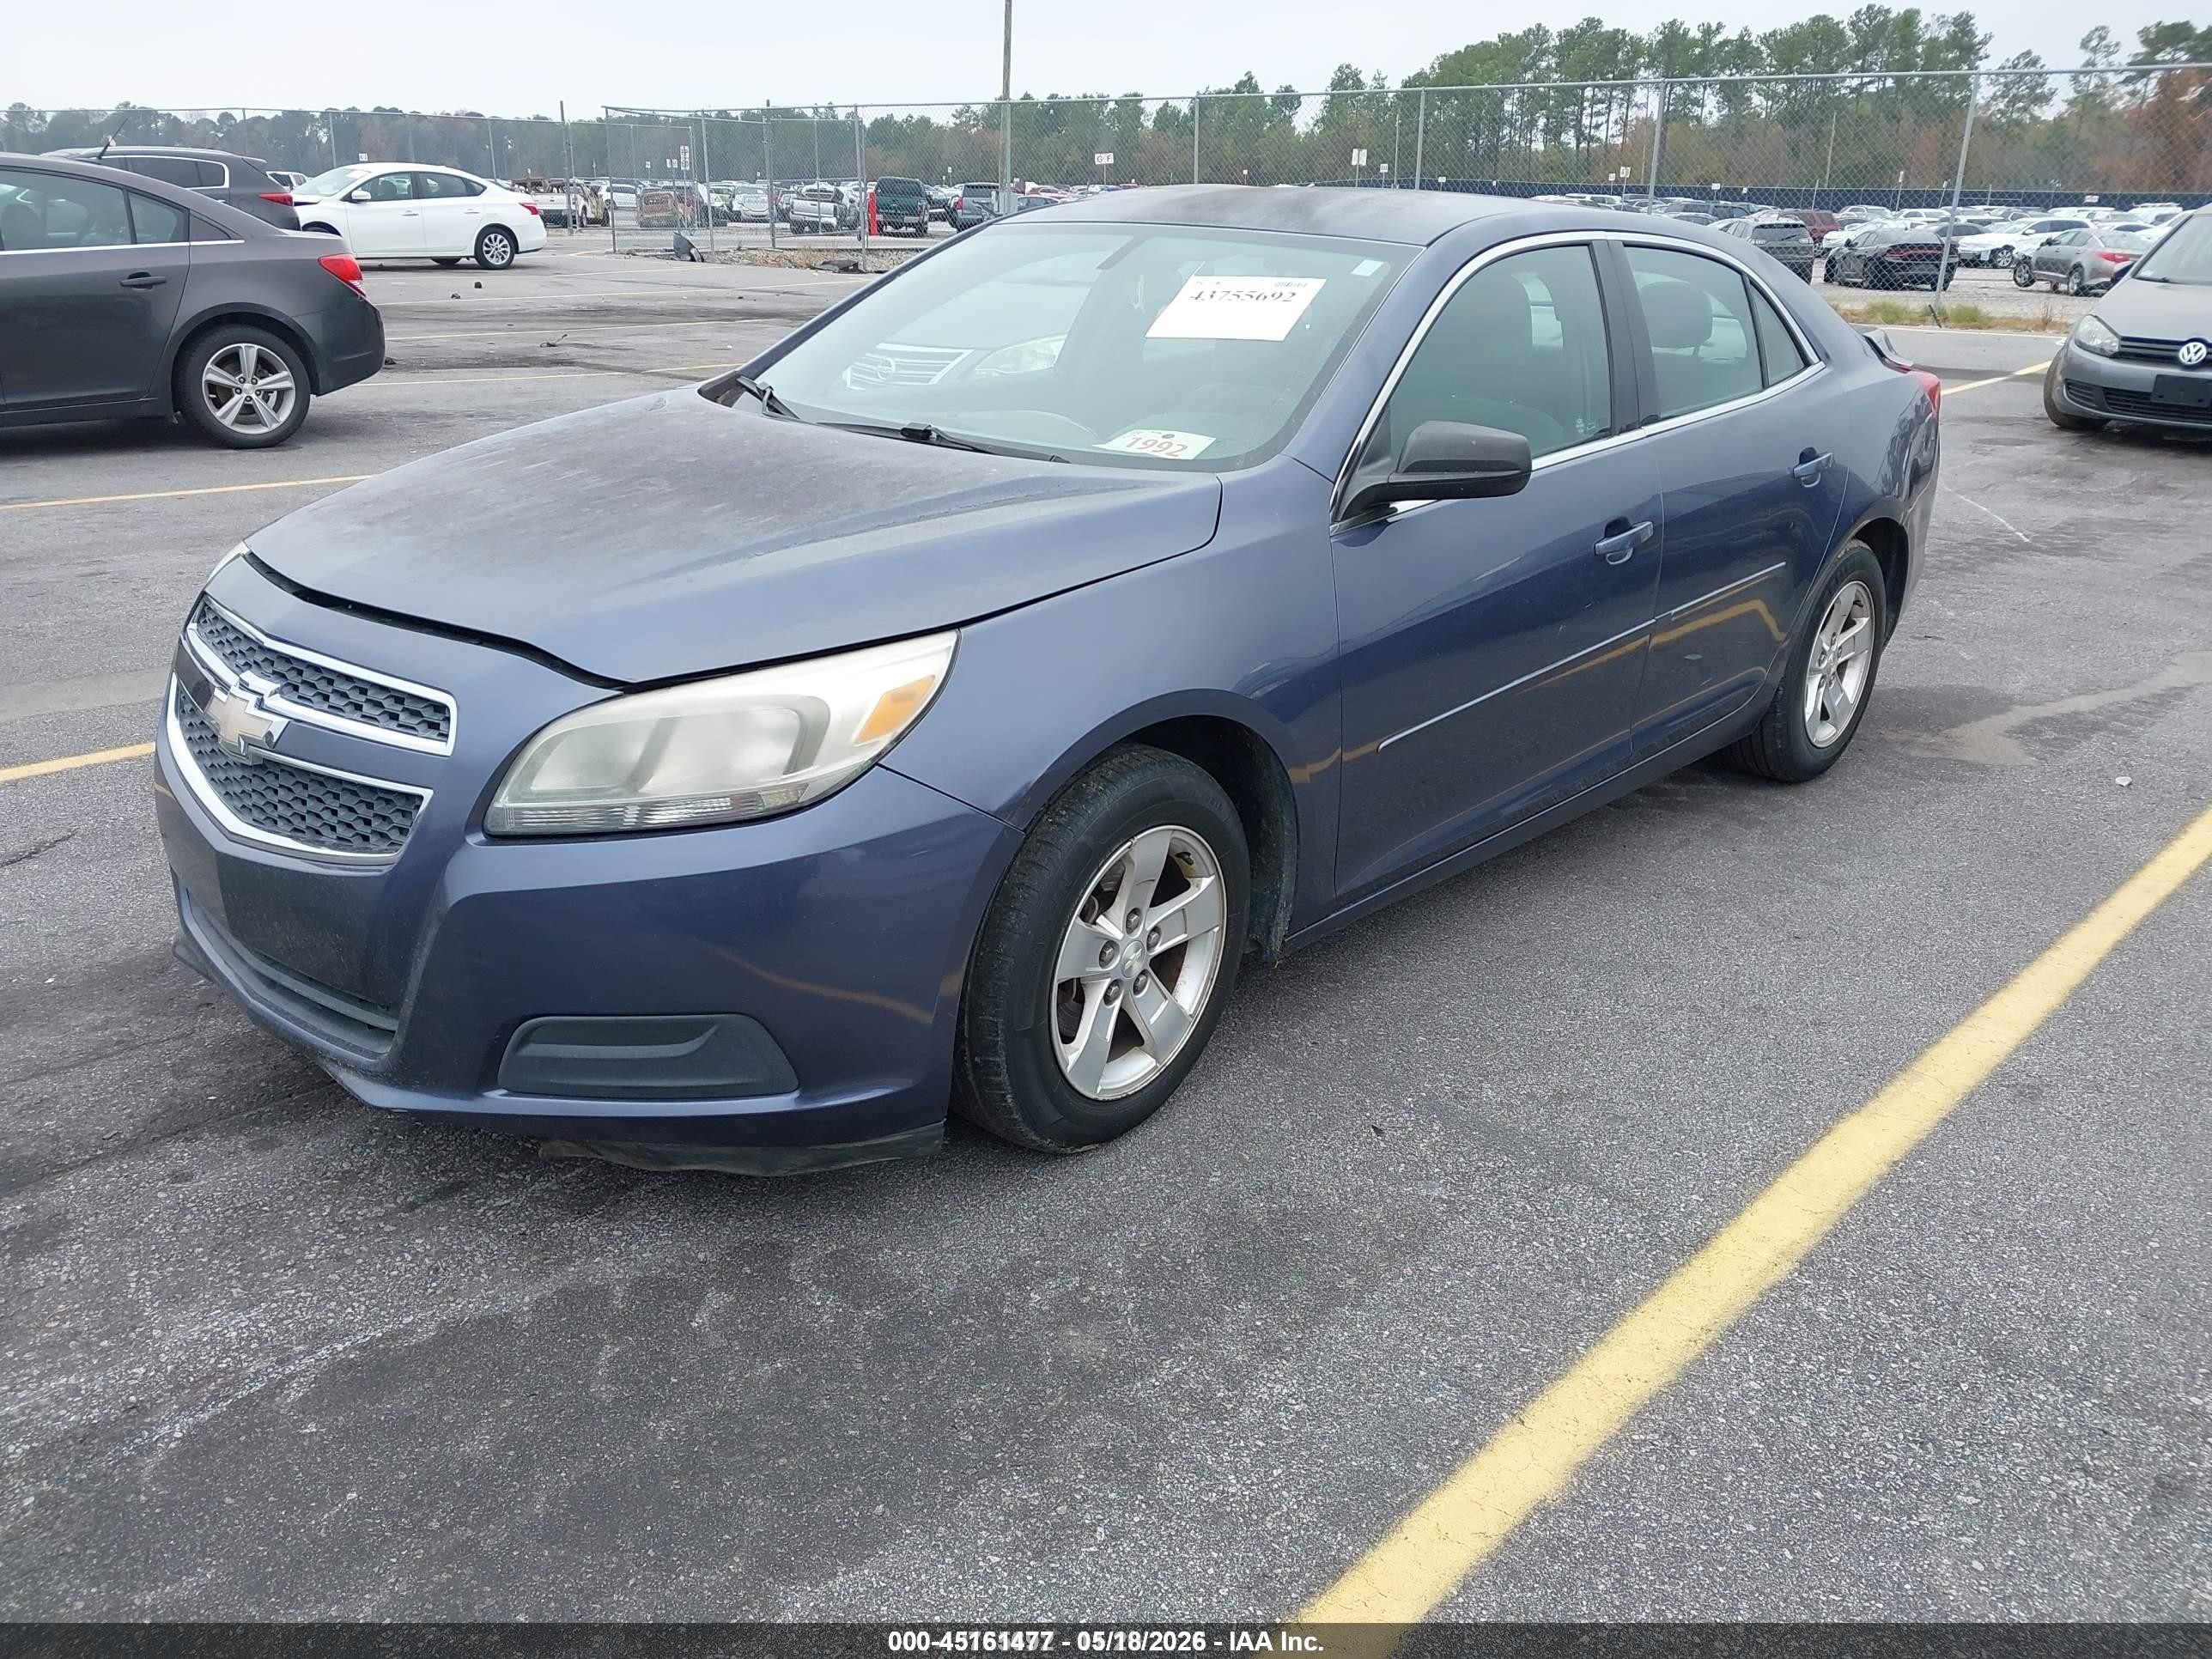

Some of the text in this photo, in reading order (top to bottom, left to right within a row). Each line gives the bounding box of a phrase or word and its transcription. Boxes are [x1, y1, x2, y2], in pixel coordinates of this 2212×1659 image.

[1188, 289, 1297, 302] 43755692
[2179, 342, 2207, 365] VW
[1126, 436, 1188, 458] 1992
